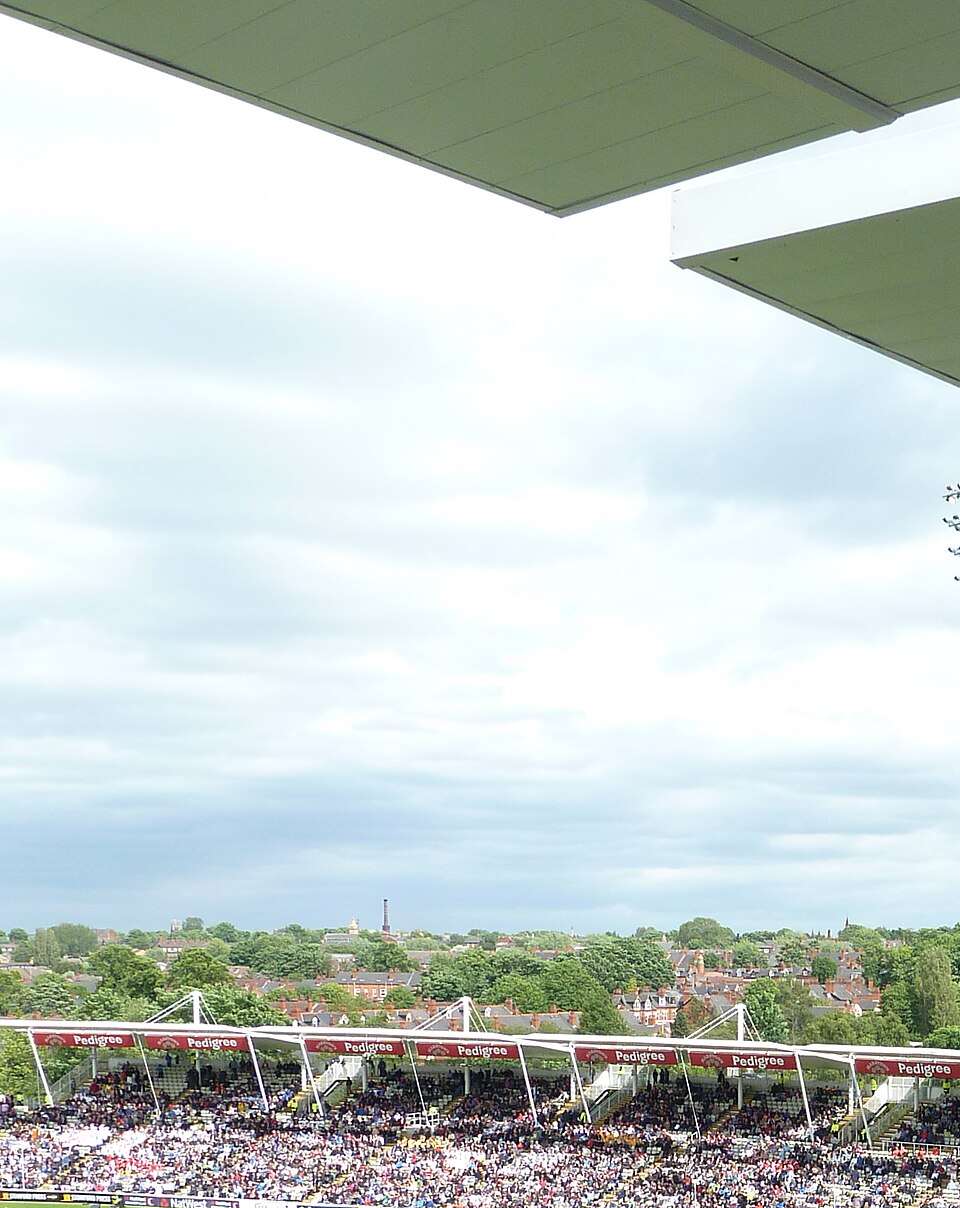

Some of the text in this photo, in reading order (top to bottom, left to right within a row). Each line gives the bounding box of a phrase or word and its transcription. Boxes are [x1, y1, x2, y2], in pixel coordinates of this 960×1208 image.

[74, 1035, 123, 1048] Pedigree
[187, 1037, 237, 1050] Pedigree
[344, 1042, 393, 1055] Pedigree
[457, 1045, 508, 1058] Pedigree
[615, 1050, 666, 1064] Pedigree
[732, 1055, 784, 1069] Pedigree
[898, 1062, 951, 1078] Pedigree
